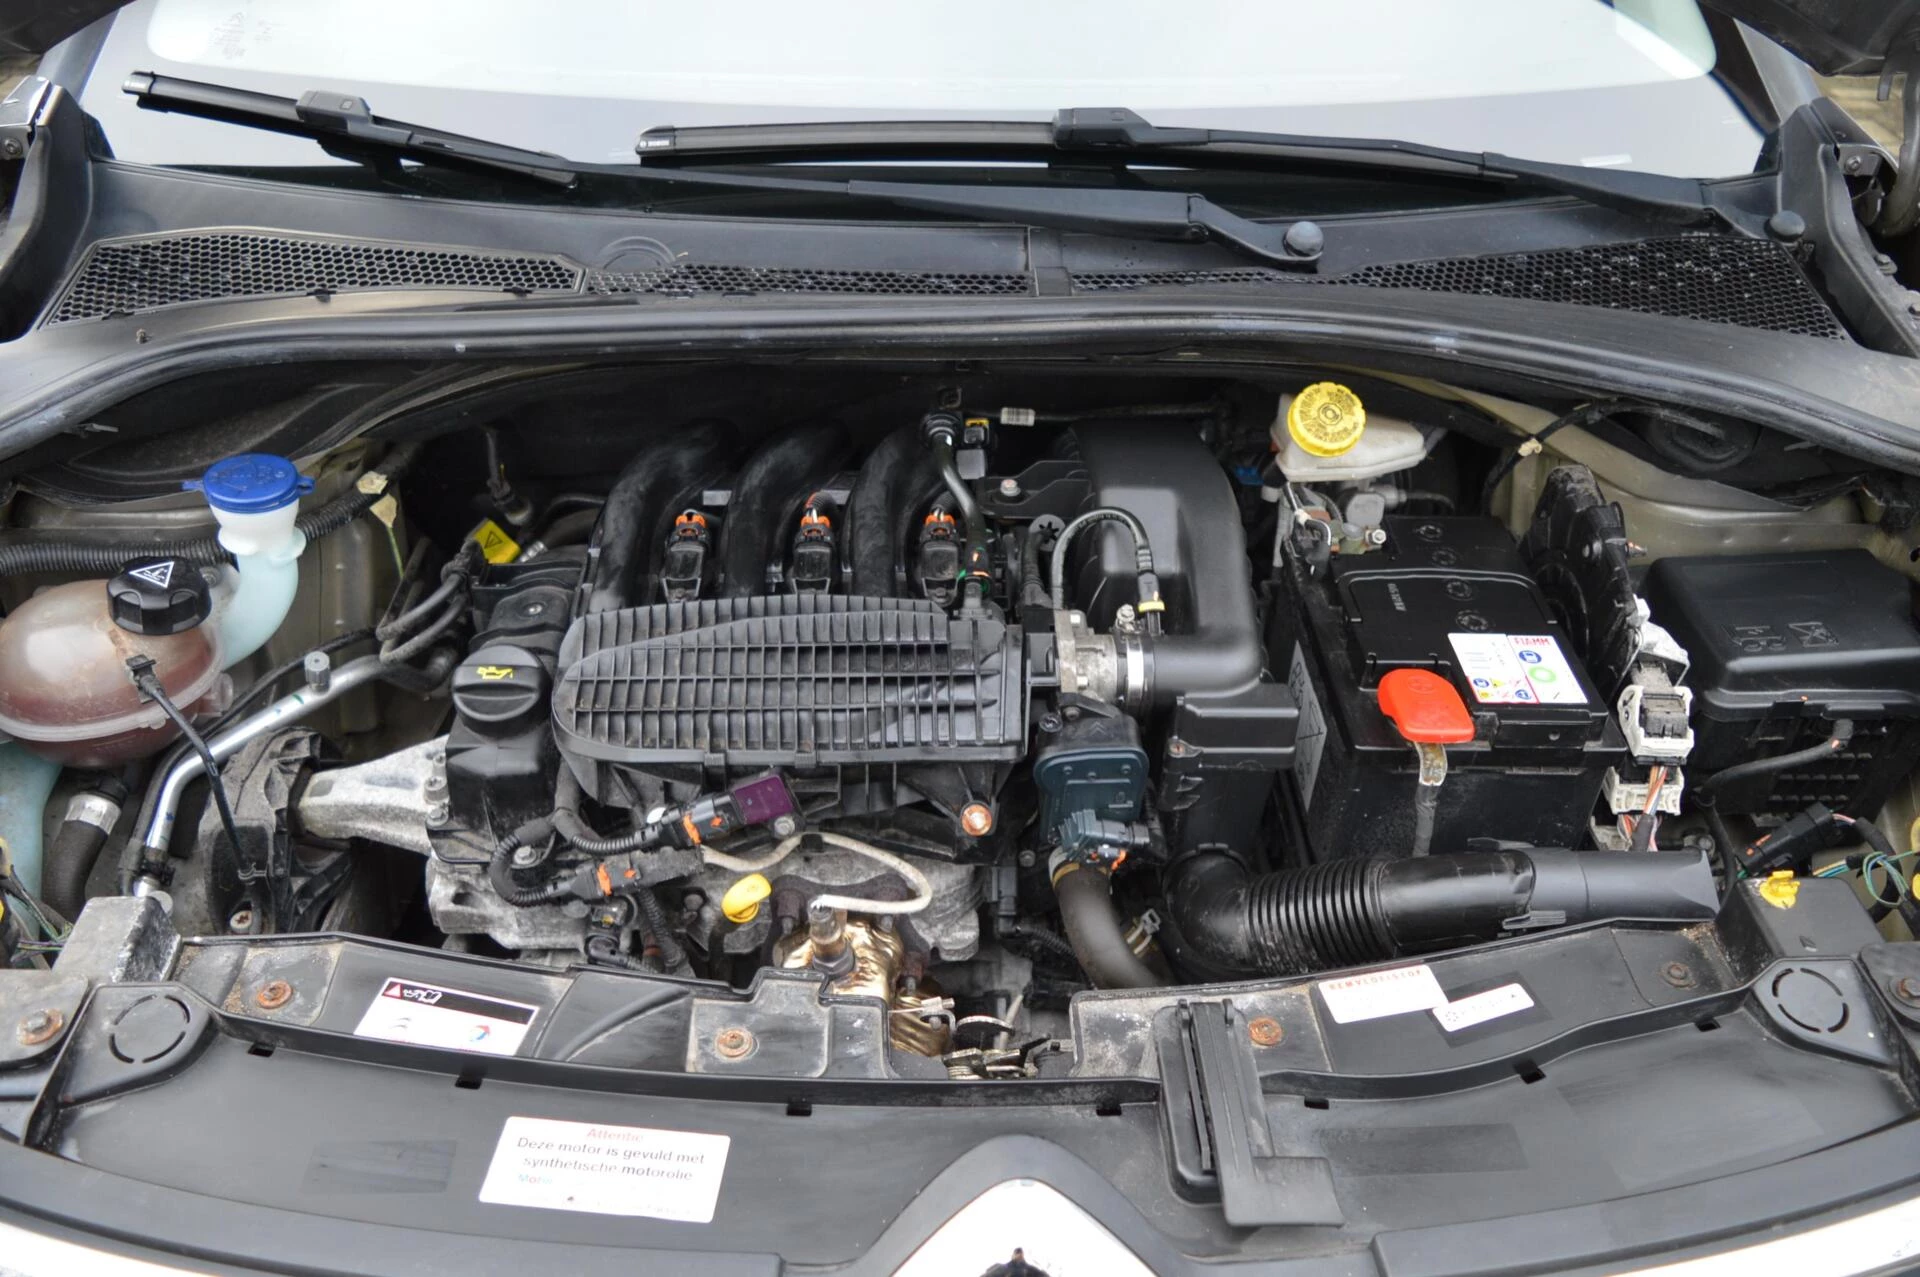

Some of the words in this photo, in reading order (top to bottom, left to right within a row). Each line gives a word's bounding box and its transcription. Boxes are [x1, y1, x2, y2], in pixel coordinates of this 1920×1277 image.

[517, 1136, 554, 1151] Deze
[558, 1143, 602, 1155] motor
[606, 1145, 619, 1157] is
[623, 1148, 673, 1162] gevuld
[676, 1152, 705, 1165] met
[621, 1164, 693, 1181] motorolie
